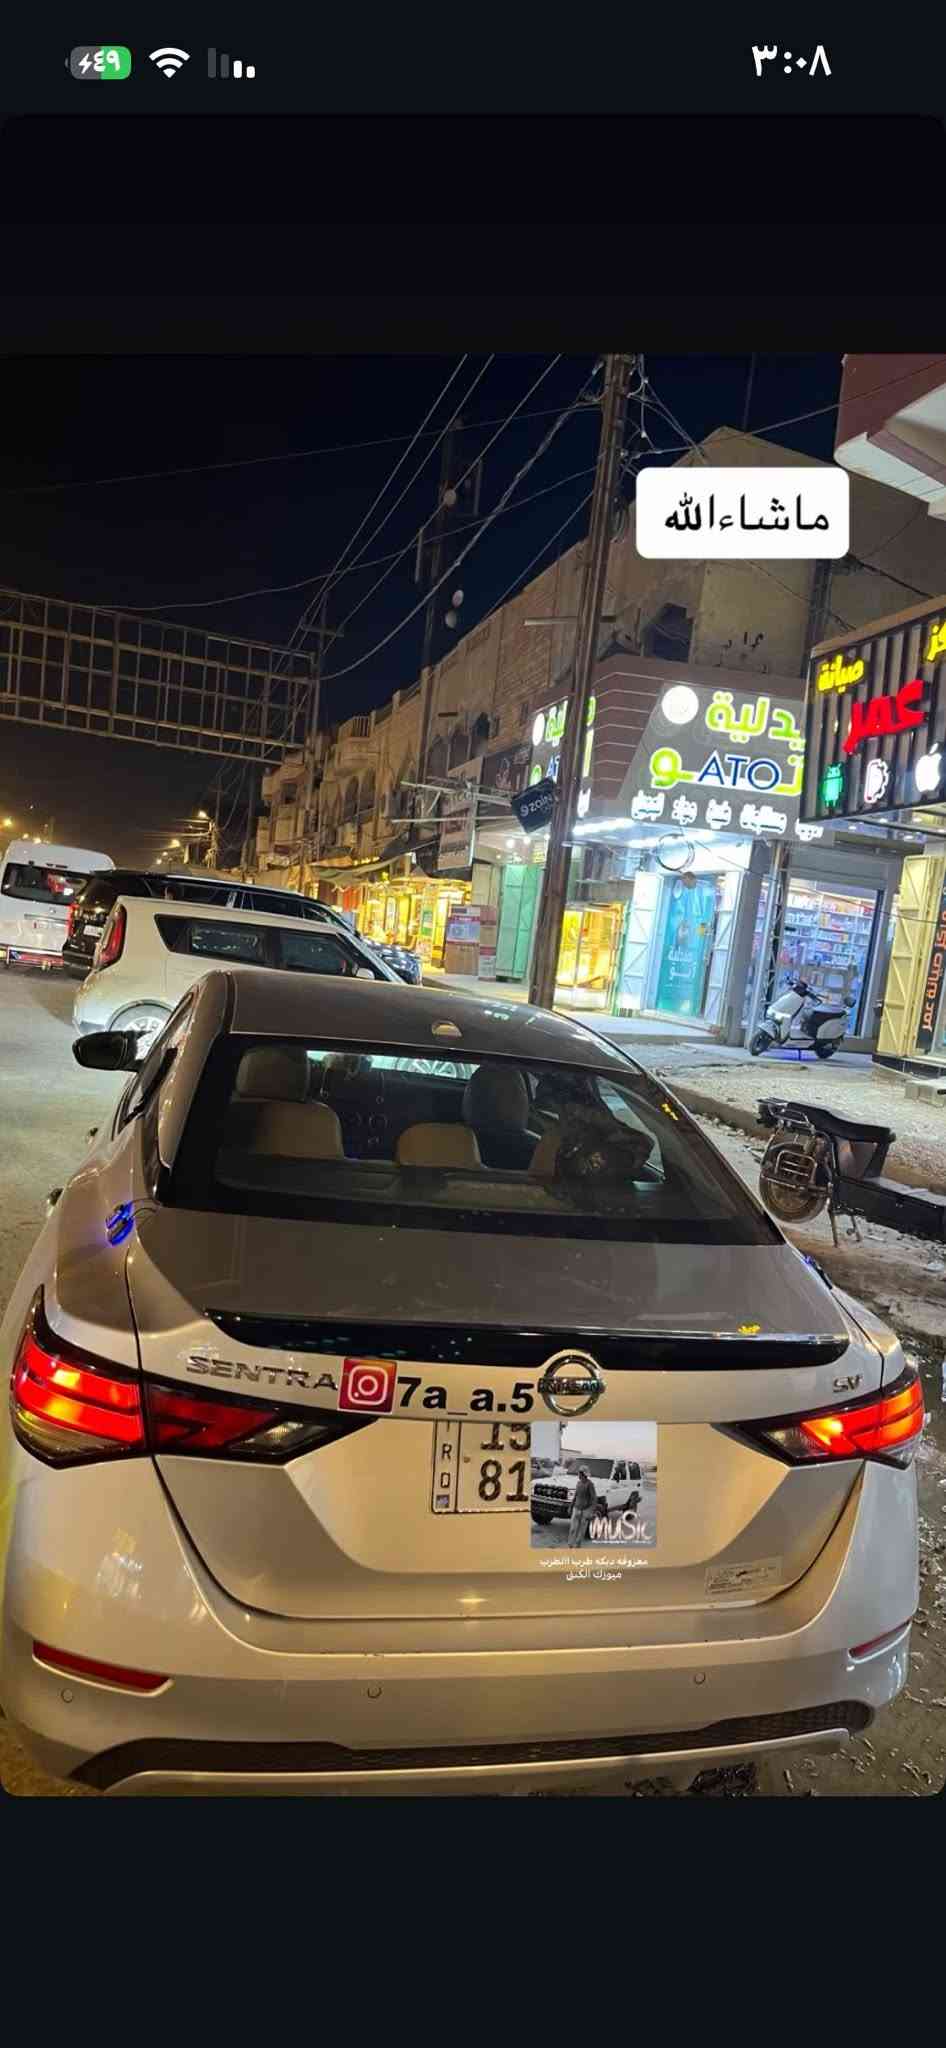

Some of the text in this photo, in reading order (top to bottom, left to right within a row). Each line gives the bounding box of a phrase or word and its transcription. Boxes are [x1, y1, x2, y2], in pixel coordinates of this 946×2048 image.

[841, 678, 927, 754] عمر
[698, 750, 783, 791] ATO
[185, 1354, 338, 1392] SENTRA
[832, 1374, 861, 1393] SV
[478, 1459, 530, 1502] 81
